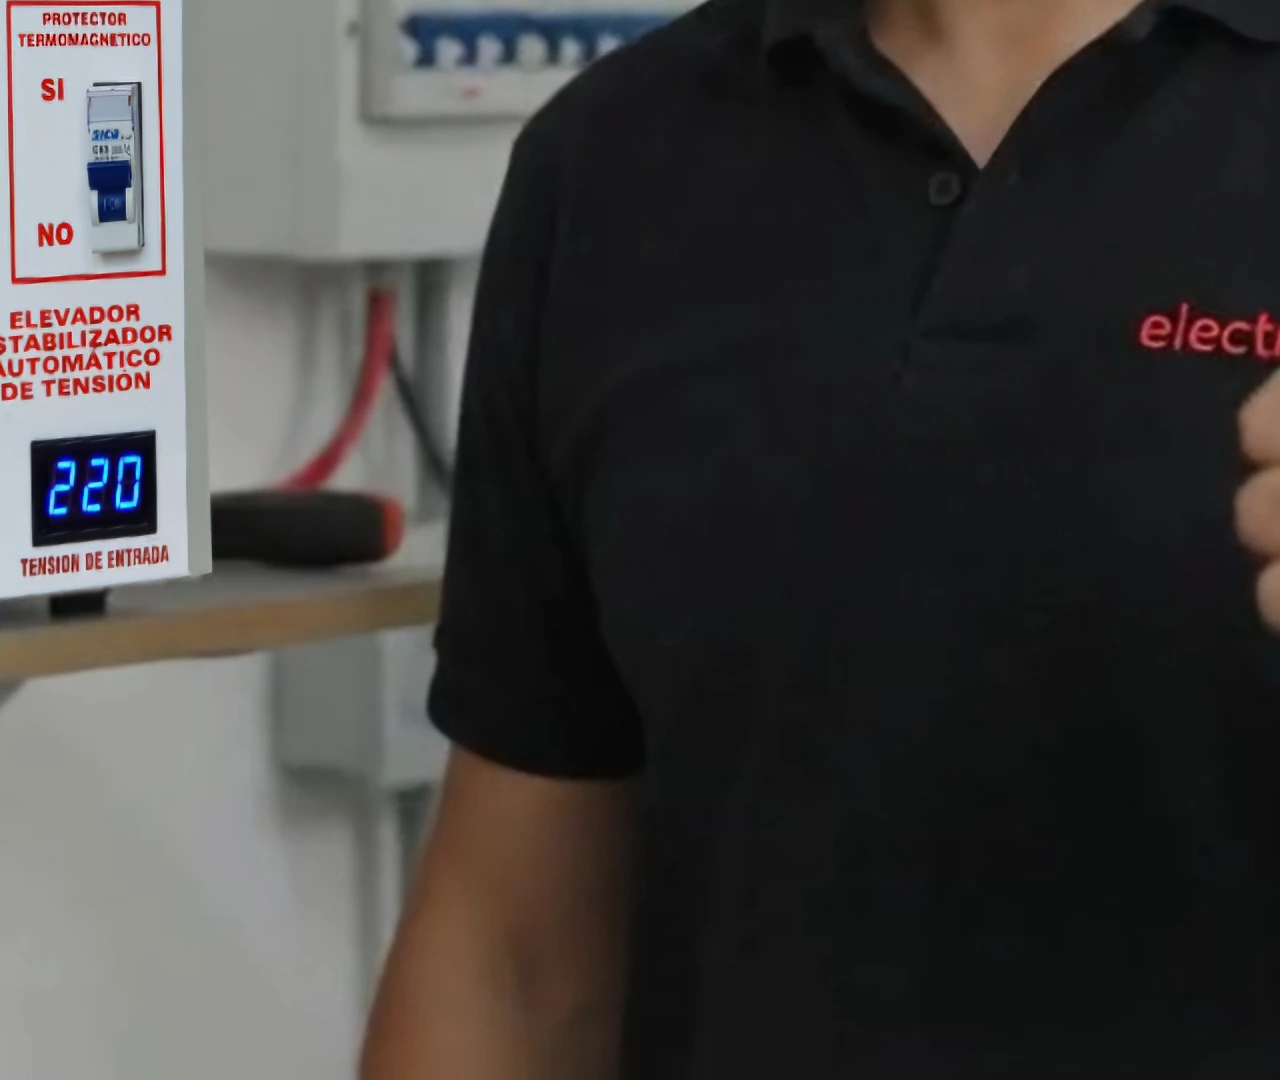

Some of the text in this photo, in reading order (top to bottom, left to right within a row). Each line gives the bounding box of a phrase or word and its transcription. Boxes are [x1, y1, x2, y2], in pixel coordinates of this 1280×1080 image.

[42, 11, 127, 26] PROTECTOR
[18, 32, 151, 47] TERMOMAGNETICO
[40, 77, 65, 102] SI
[37, 222, 74, 247] NO
[9, 303, 141, 330] ELEVADOR
[0, 382, 34, 401] DE
[48, 454, 142, 516] 220
[20, 544, 170, 577] TENSION DE ENTRADA
